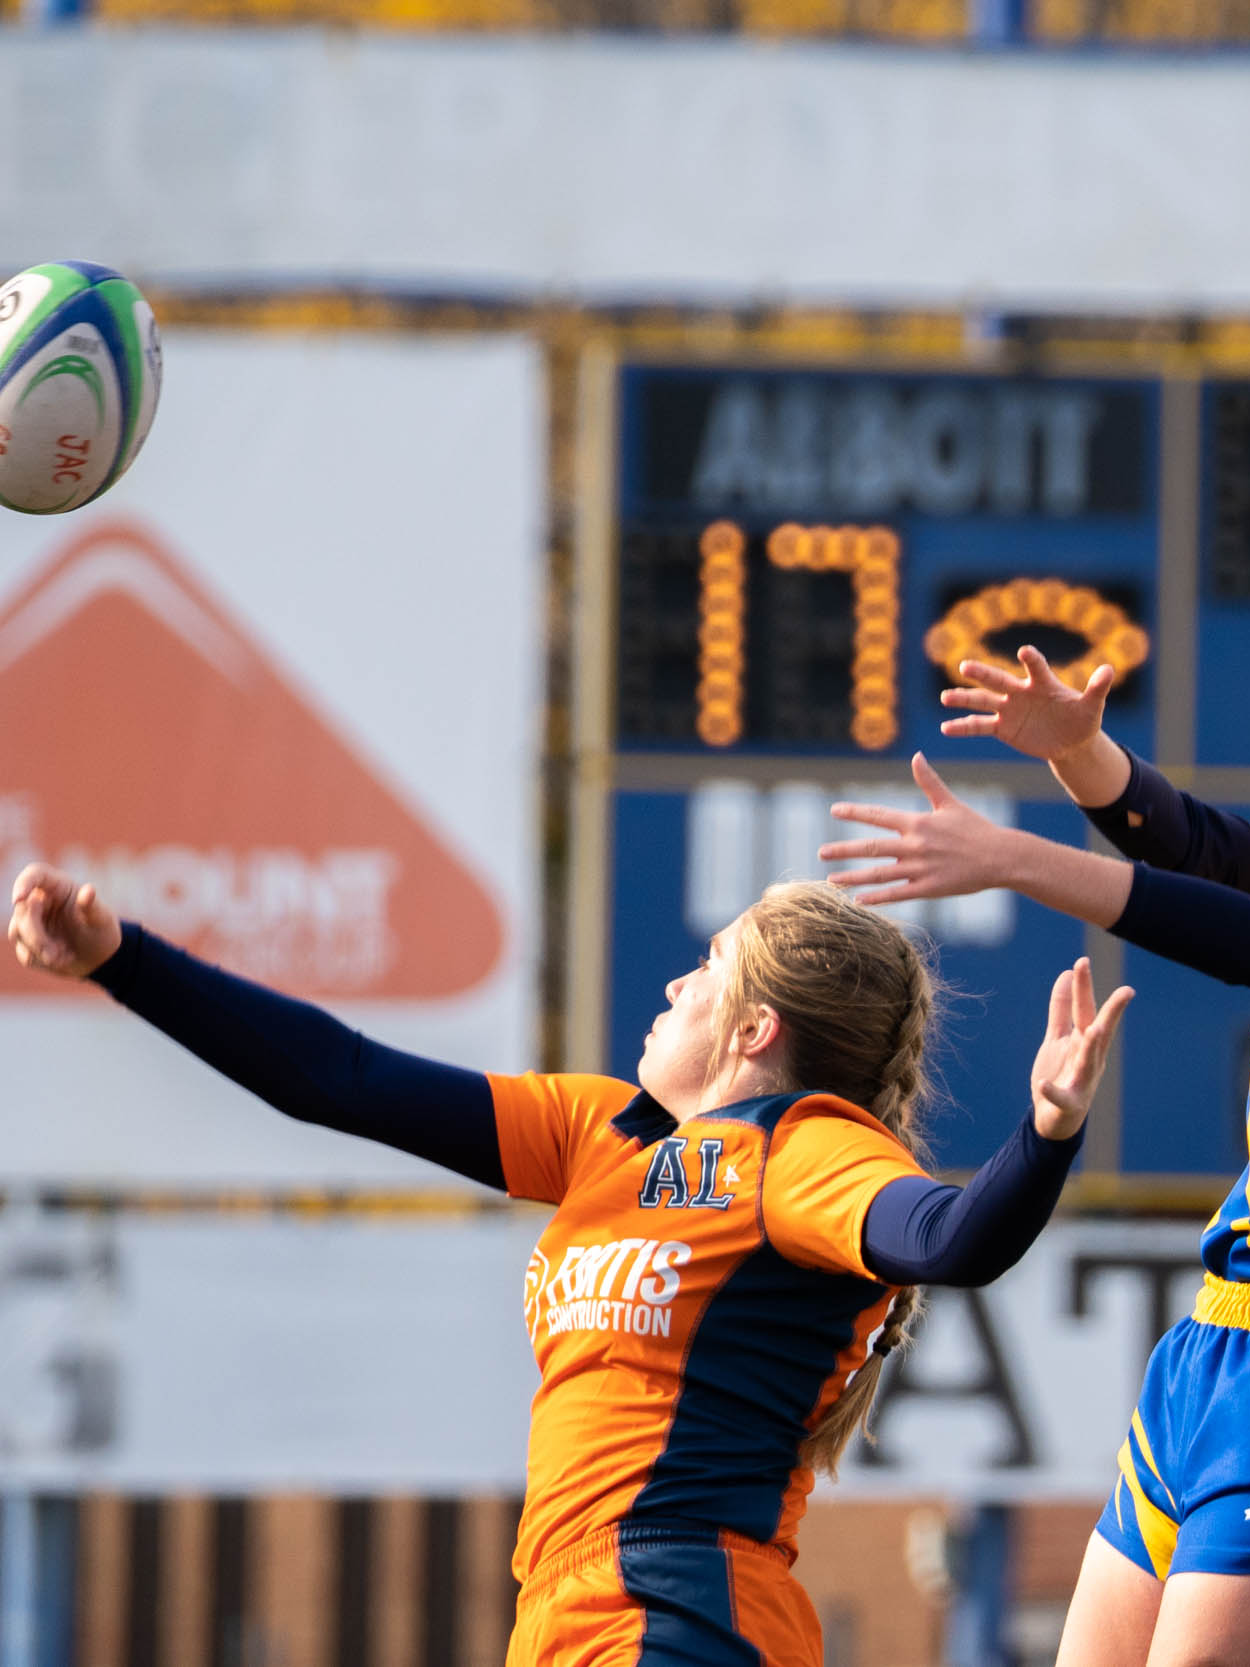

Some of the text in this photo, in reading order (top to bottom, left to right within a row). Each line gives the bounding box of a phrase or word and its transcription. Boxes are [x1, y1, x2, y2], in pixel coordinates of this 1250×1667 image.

[52, 434, 90, 484] JAC
[697, 520, 899, 750] 17
[639, 1136, 736, 1211] AL
